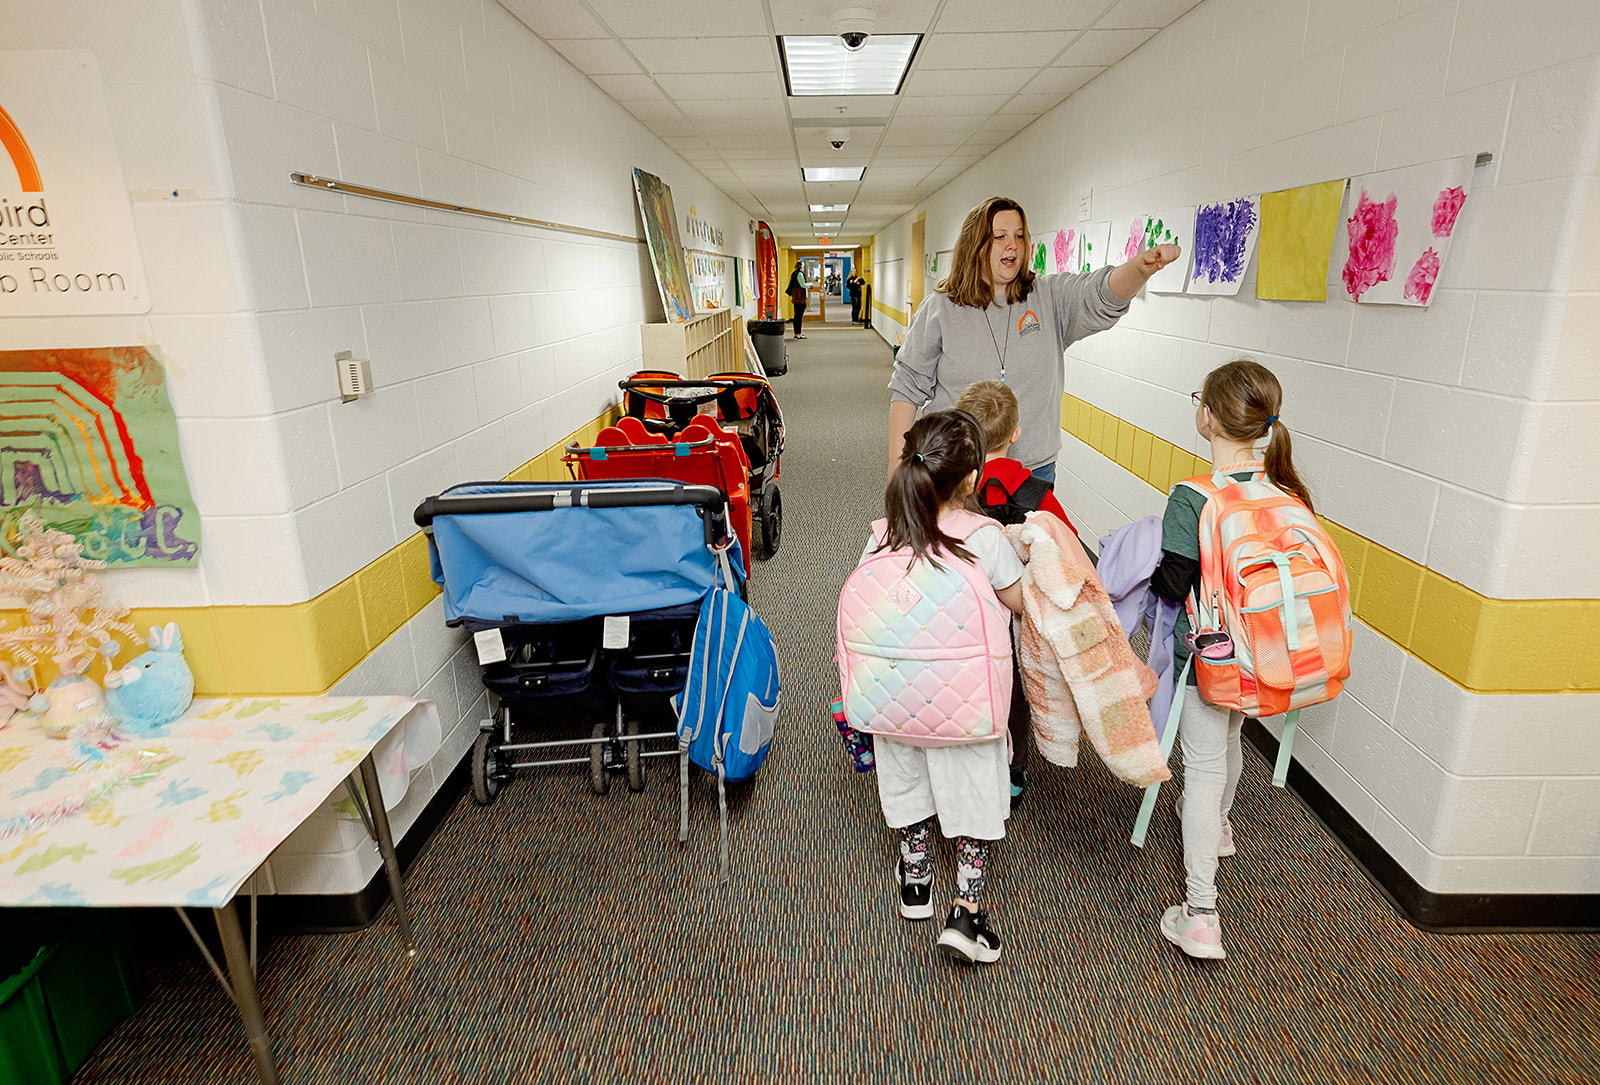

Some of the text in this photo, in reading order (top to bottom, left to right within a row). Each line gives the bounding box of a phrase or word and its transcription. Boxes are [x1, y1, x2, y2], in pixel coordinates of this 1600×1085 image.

[0, 197, 51, 227] ird
[0, 231, 54, 245] Center
[17, 251, 60, 261] Schools
[29, 266, 127, 292] Room
